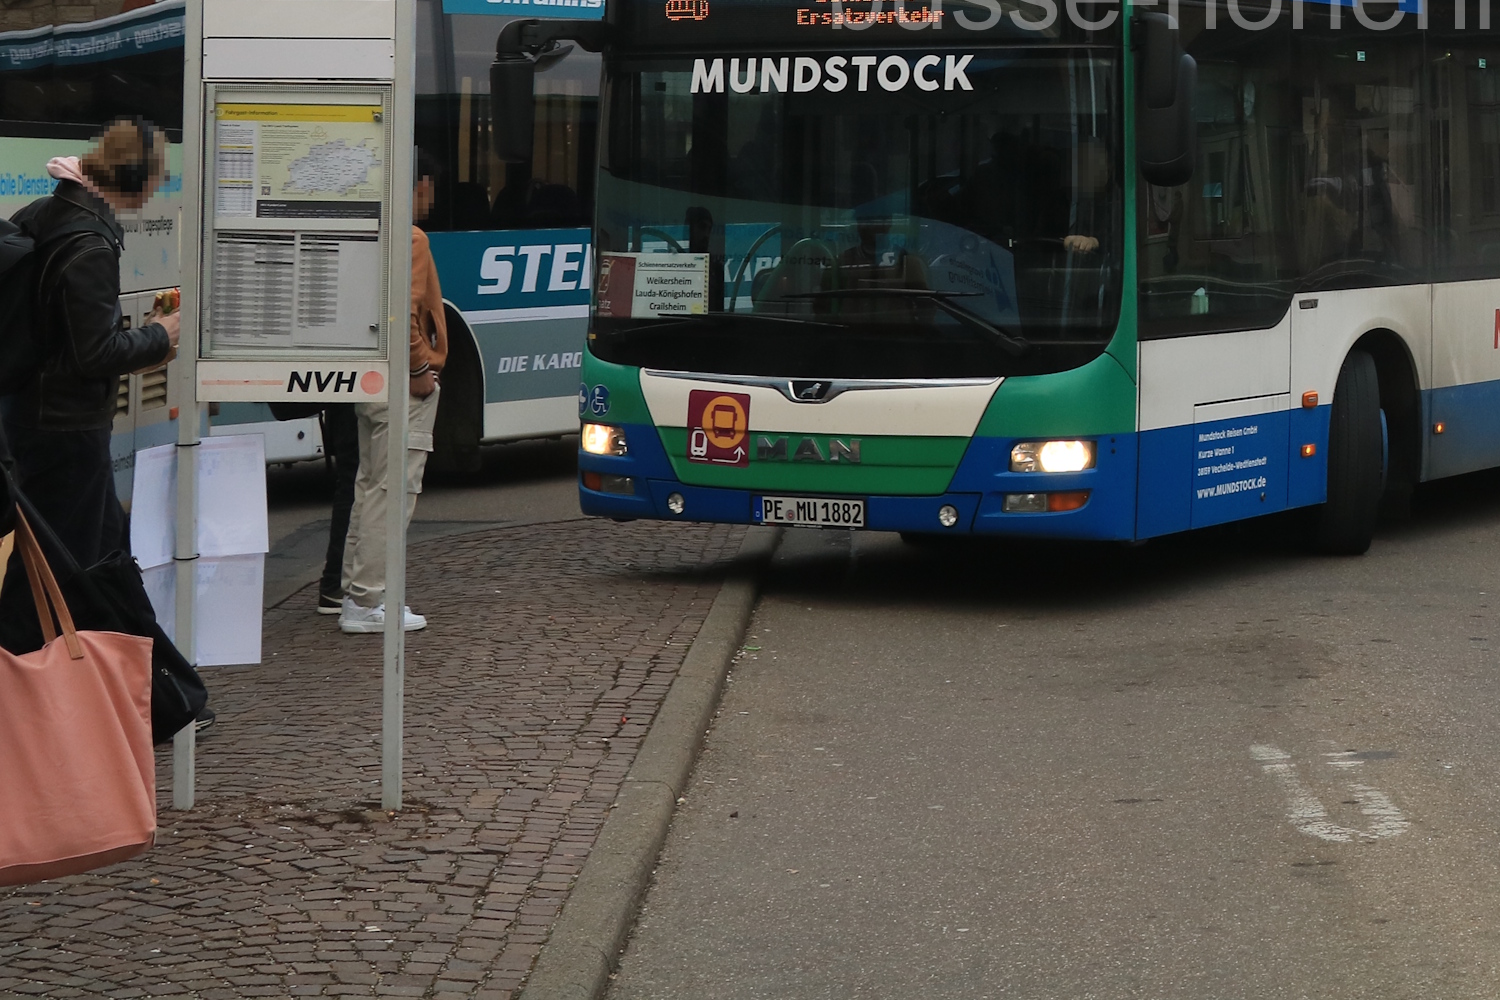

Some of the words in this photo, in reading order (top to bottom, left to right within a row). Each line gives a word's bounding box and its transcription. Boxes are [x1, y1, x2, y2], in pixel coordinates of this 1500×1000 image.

[796, 6, 945, 26] Ersatzverkehr
[689, 54, 975, 94] MUNDSTOCK
[638, 261, 697, 269] Schienenersatzverkehr
[646, 276, 692, 285] Weikersheim
[635, 290, 703, 299] Lauda-Königshofen
[649, 302, 687, 311] Crailsheim
[498, 355, 529, 374] DIE
[286, 371, 357, 393] NVH
[1198, 430, 1226, 443] Mundstock
[1226, 427, 1243, 438] Reisen
[1243, 425, 1258, 436] GmbH
[756, 434, 863, 463] MAN
[1198, 449, 1214, 460] Kurze
[1196, 475, 1267, 500] www.MUNDSTOCK.de
[763, 499, 784, 520] PE
[796, 500, 817, 521] MU
[821, 502, 862, 524] 1882
